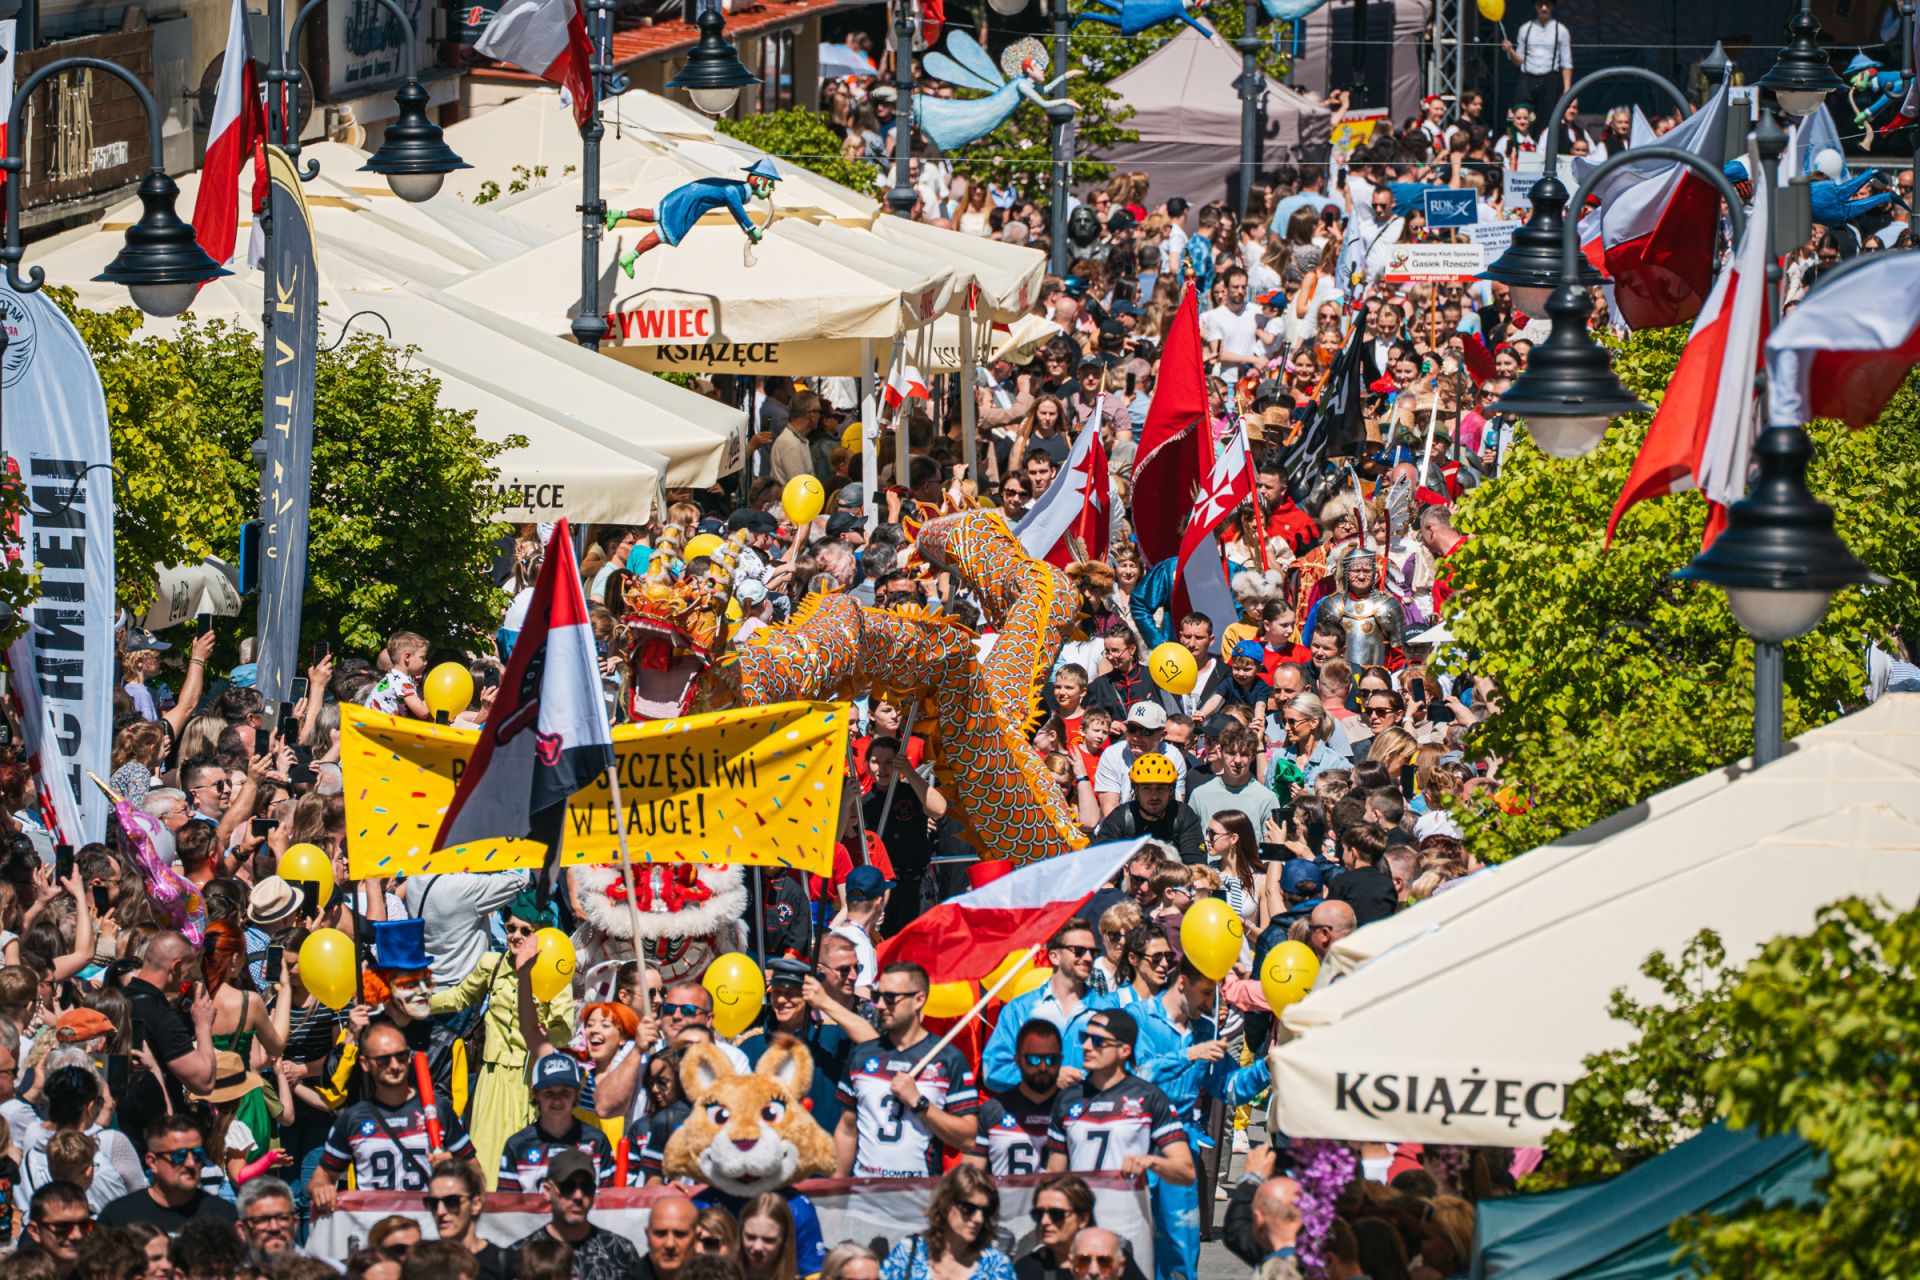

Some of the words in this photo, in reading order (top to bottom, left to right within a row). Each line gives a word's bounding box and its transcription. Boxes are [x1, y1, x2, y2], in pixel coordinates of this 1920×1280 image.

[1430, 199, 1454, 212] RDK
[1159, 660, 1180, 679] 13
[1135, 706, 1146, 717] NY
[570, 802, 594, 836] W
[1335, 1068, 1570, 1128] KSIĄŻĘC
[877, 1094, 904, 1142] 3
[370, 1148, 427, 1190] 95
[1087, 1130, 1112, 1172] 7
